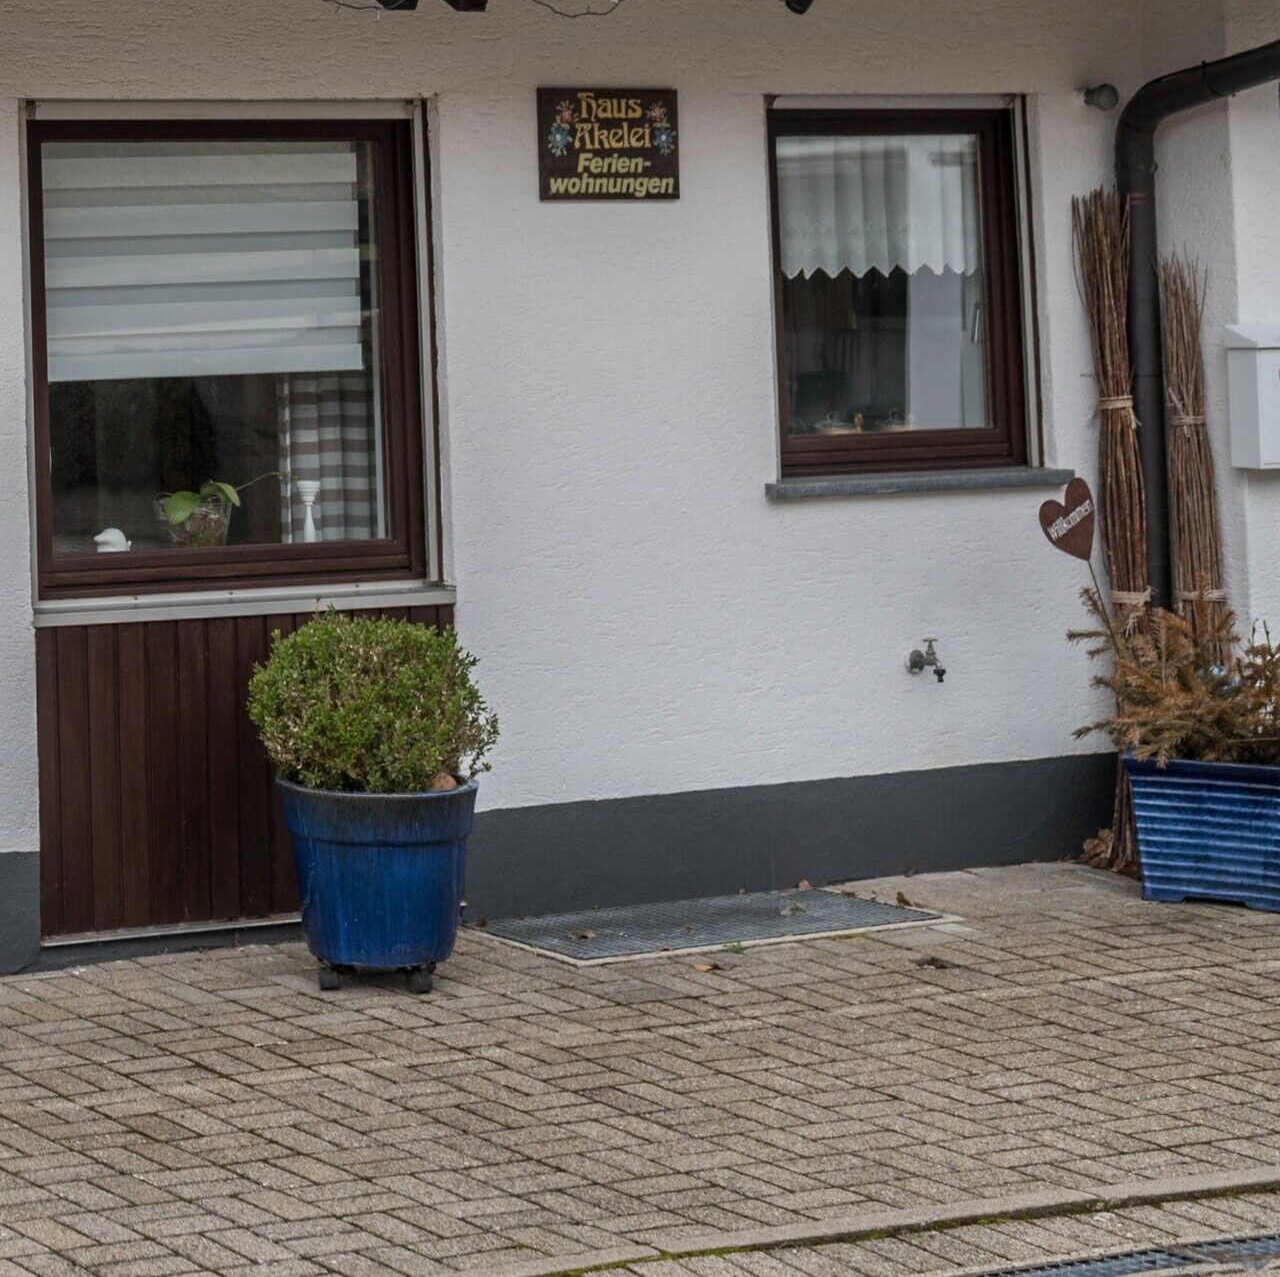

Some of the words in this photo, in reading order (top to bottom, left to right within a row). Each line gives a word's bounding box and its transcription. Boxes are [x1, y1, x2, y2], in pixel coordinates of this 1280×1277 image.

[574, 122, 652, 149] Akelei
[577, 152, 652, 174] Ferien-
[549, 173, 675, 198] wohnungen
